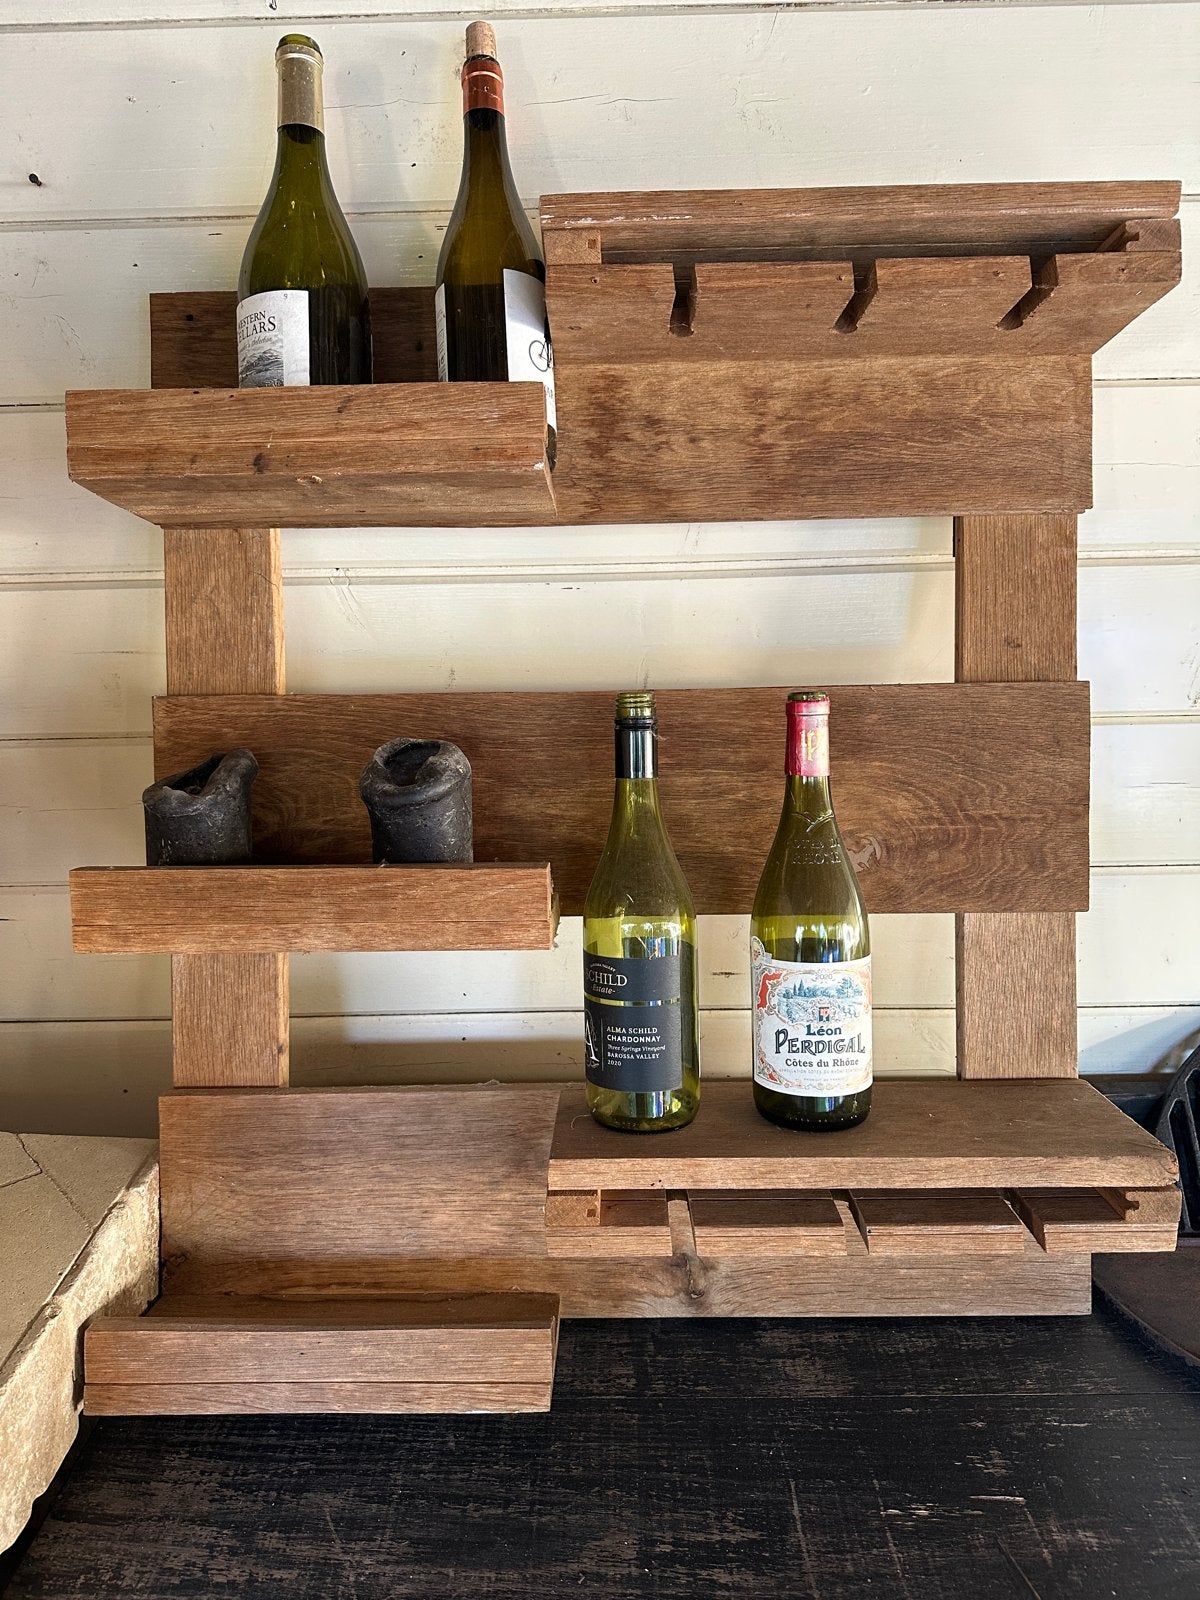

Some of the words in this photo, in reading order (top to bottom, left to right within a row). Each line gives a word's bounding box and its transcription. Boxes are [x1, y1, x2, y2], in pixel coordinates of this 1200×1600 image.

[606, 1026, 627, 1034] ALMA
[805, 1023, 842, 1036] Léon
[606, 1034, 661, 1043] CHARDONNAY
[774, 1027, 866, 1056] PERDIGAL
[607, 1052, 635, 1060] BAROSSA
[785, 1058, 814, 1068] Côtes
[816, 1058, 829, 1068] du
[832, 1058, 859, 1067] Rhône
